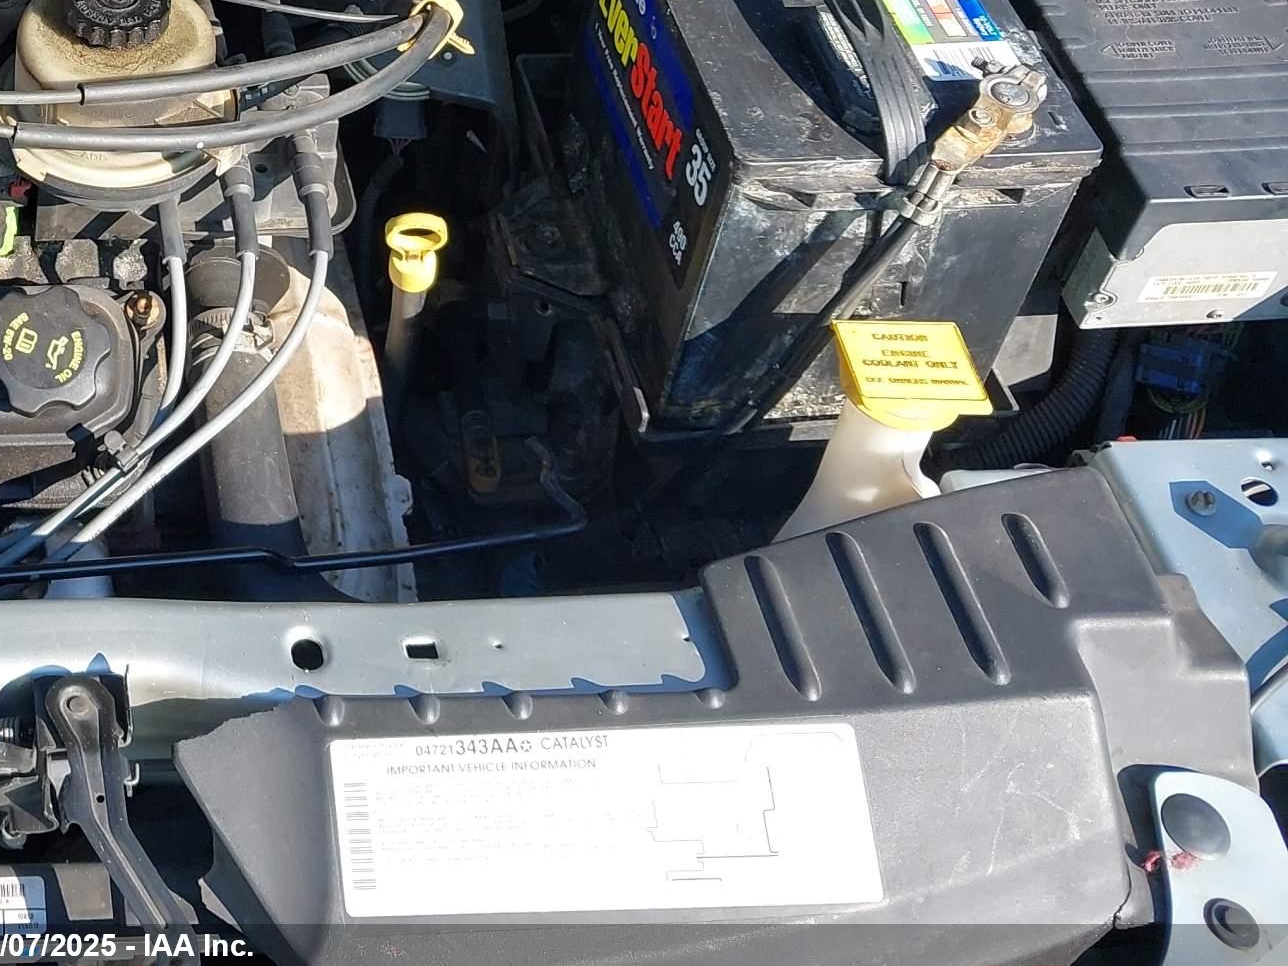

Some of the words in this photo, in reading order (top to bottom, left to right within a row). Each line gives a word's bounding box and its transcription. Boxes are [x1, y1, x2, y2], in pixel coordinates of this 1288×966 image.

[685, 144, 712, 206] 35
[8, 312, 30, 331] SAE
[70, 330, 84, 371] ENGINE
[862, 359, 919, 368] COOLANT
[925, 360, 958, 369] ONLY
[54, 368, 73, 383] OIL
[540, 735, 609, 750] CATALYST
[386, 763, 454, 776] IMPORTANT
[458, 761, 507, 773] VEHICLE
[511, 759, 597, 772] INFORMATION
